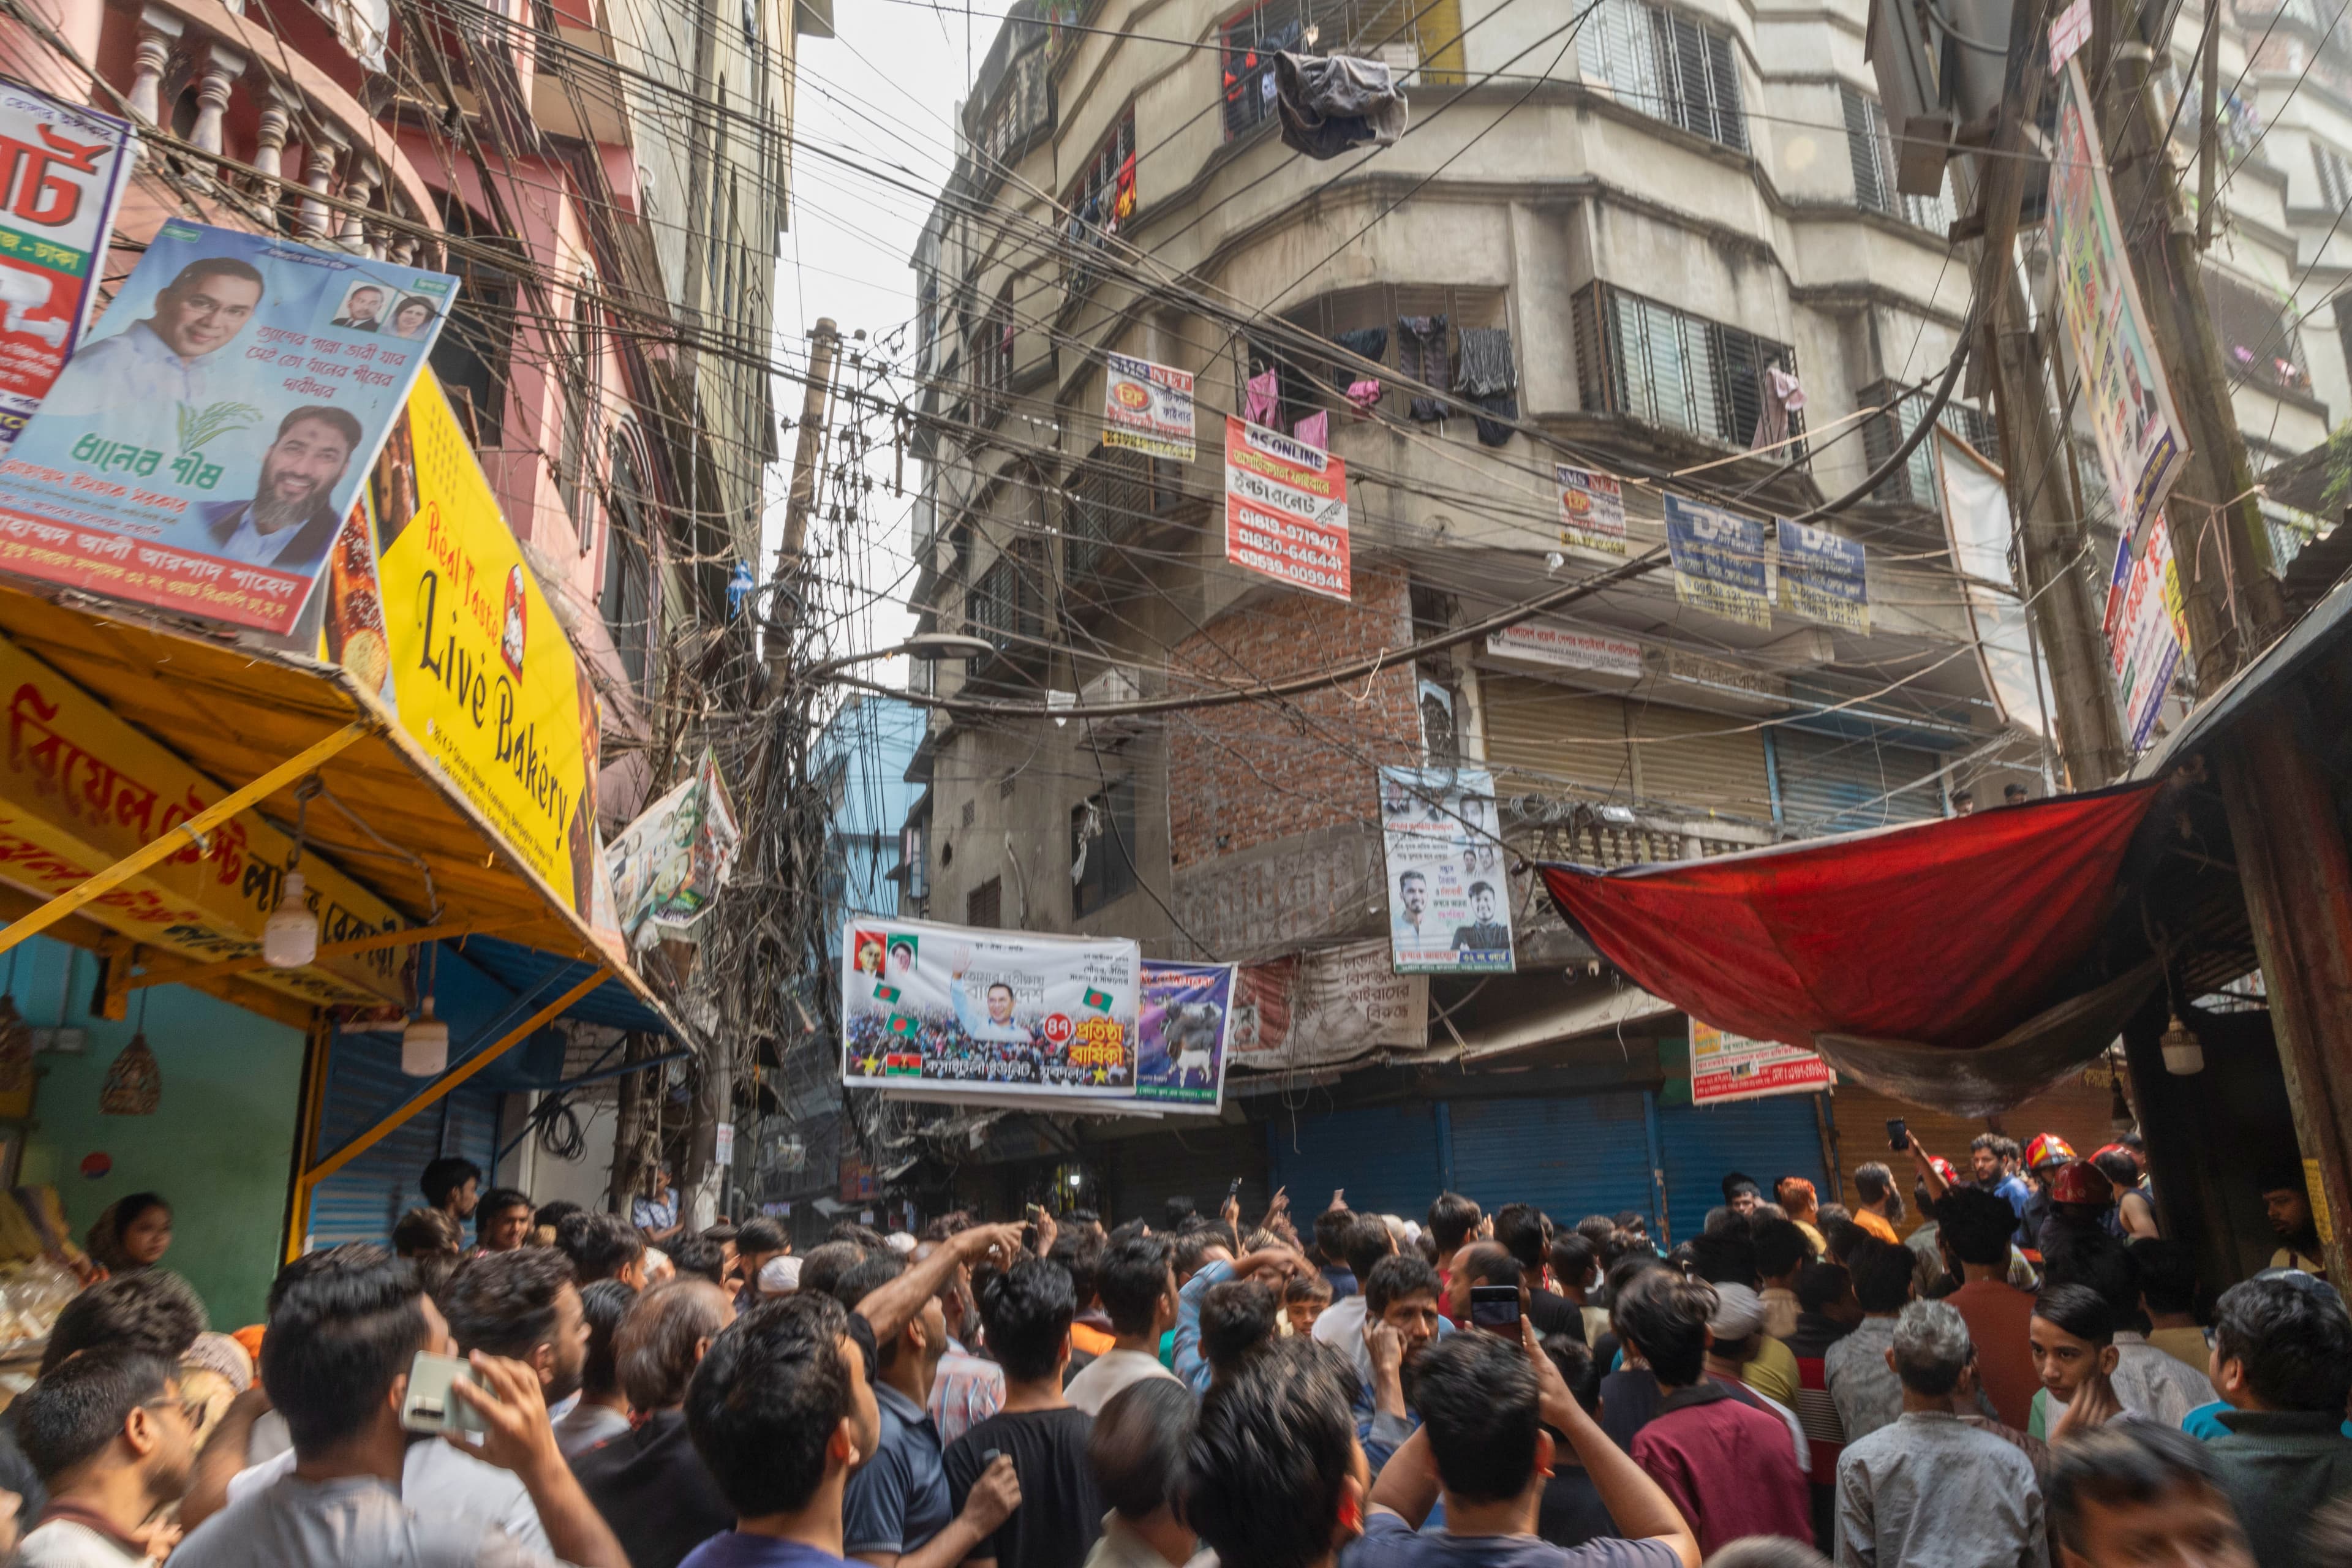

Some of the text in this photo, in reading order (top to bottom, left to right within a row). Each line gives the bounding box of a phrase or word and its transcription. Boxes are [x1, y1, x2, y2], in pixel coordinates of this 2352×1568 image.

[246, 345, 396, 388] সেই তো ধানের শীষের
[311, 337, 341, 355] পাল্লা
[344, 341, 377, 363] ভারী
[379, 352, 409, 368] যার
[1109, 355, 1191, 389] SMS NET
[282, 376, 339, 399] দাবীদার
[70, 432, 225, 491] ধানের শীষ
[1250, 430, 1323, 469] AS ONLINE
[1233, 448, 1330, 495] অপটিক্যাল ফাইবারে
[1234, 469, 1316, 514] ইন্টারনেট
[1557, 468, 1586, 488] SMS
[1239, 507, 1340, 552] 01819-971947
[426, 500, 500, 647] Real Taste
[418, 570, 486, 729] Live
[494, 674, 568, 852] Bakery
[7, 682, 159, 847] রিয়েল
[962, 970, 1000, 984] তোমার
[1047, 1017, 1068, 1038] ৪৭
[1076, 1016, 1125, 1041] প্রতিষ্ঠা
